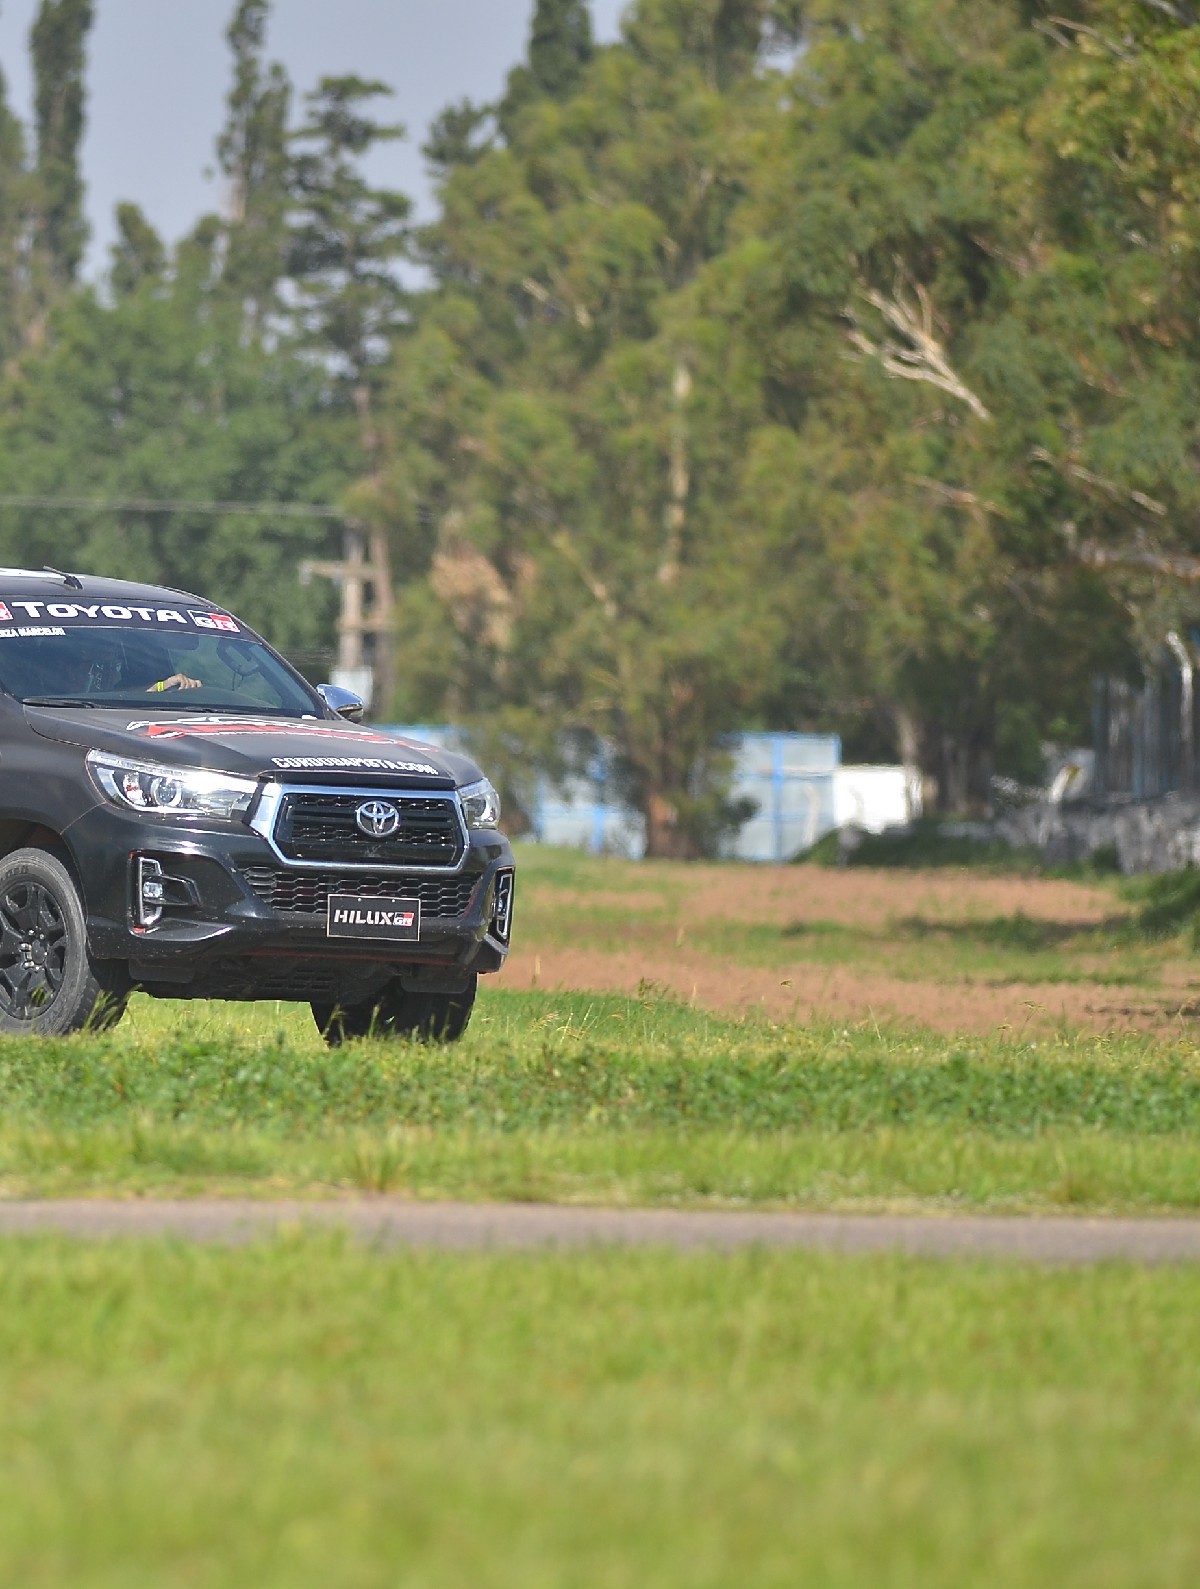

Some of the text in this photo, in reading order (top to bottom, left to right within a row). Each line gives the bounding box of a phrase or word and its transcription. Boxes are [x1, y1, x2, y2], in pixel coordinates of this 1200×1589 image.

[11, 601, 188, 624] TOYOTA
[193, 615, 239, 631] GR
[271, 757, 439, 775] CORDOBAPISTA.COM
[334, 909, 394, 925] HILUX
